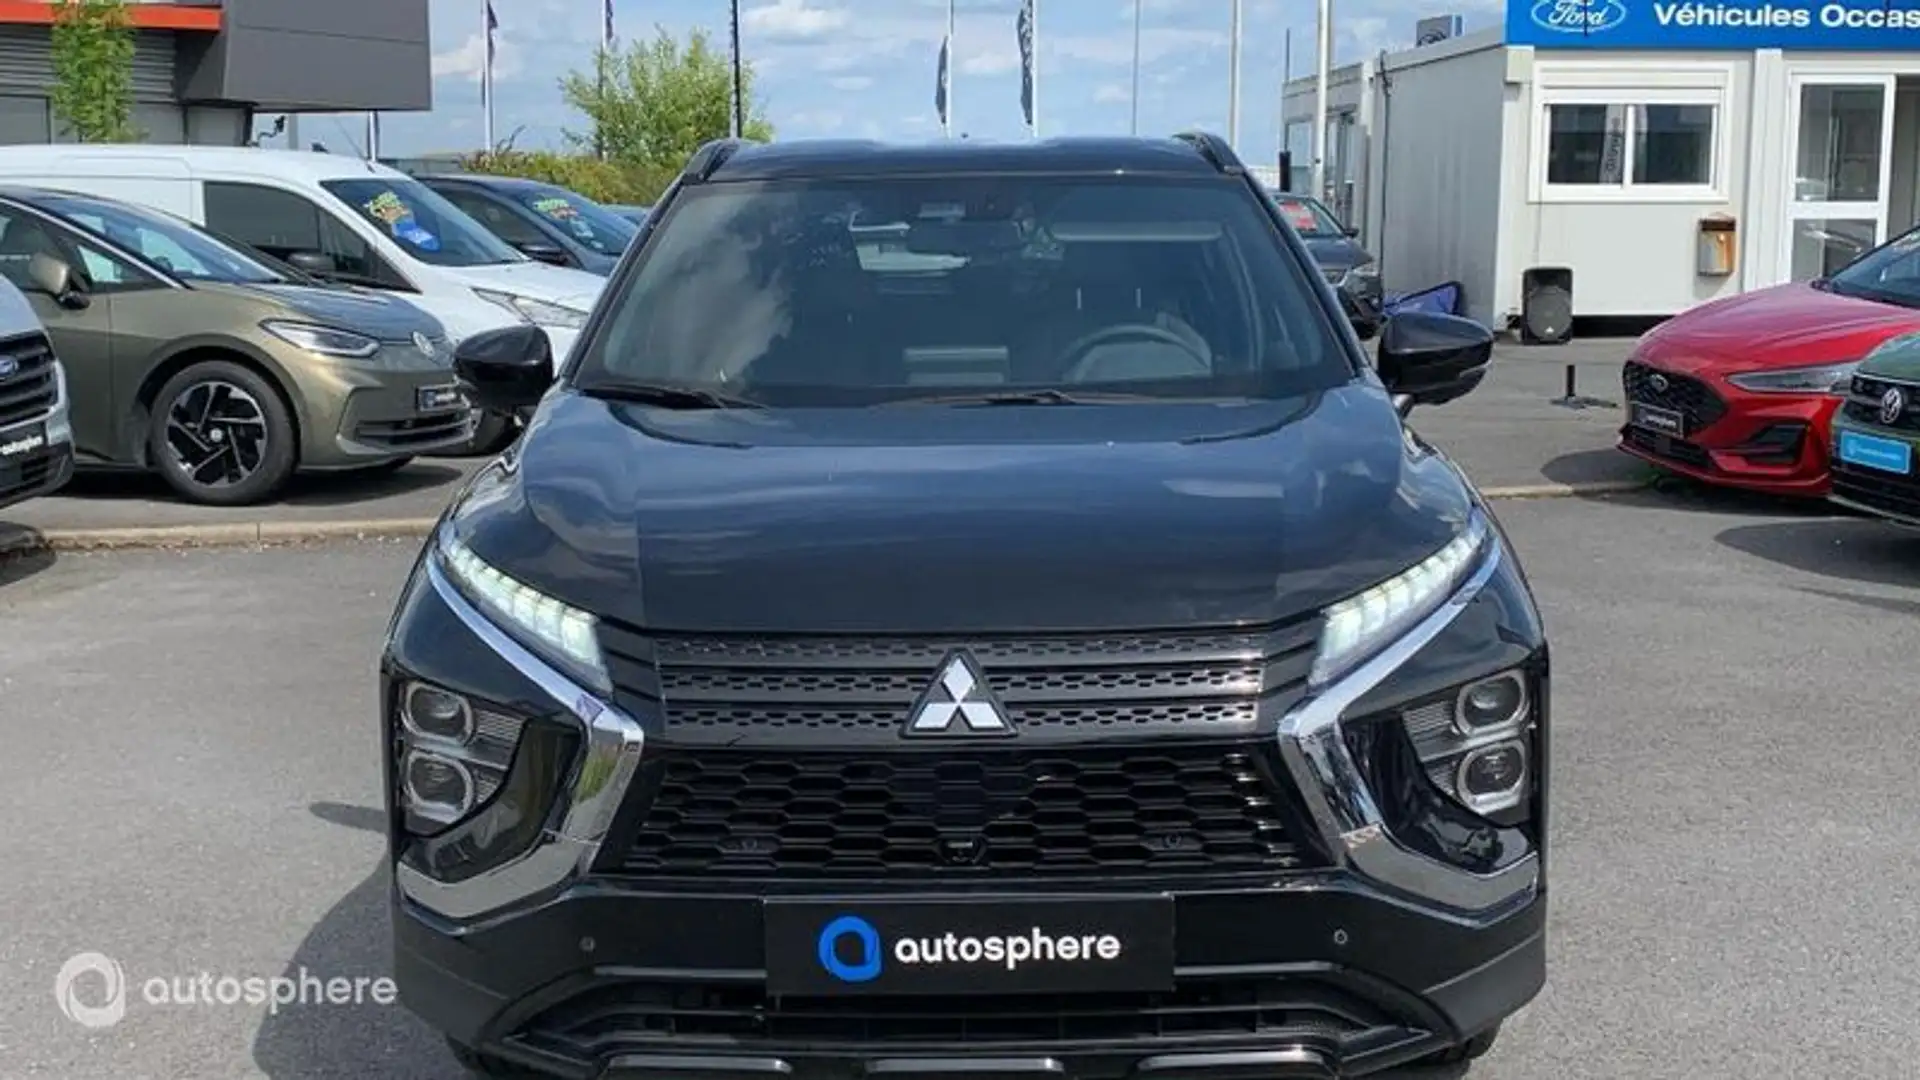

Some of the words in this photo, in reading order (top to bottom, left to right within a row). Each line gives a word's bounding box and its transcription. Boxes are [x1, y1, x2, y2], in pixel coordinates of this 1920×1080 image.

[1548, 0, 1610, 25] Ford
[1653, 2, 1811, 27] Véhicules
[1820, 4, 1920, 28] Occas
[894, 926, 1122, 970] autosphere
